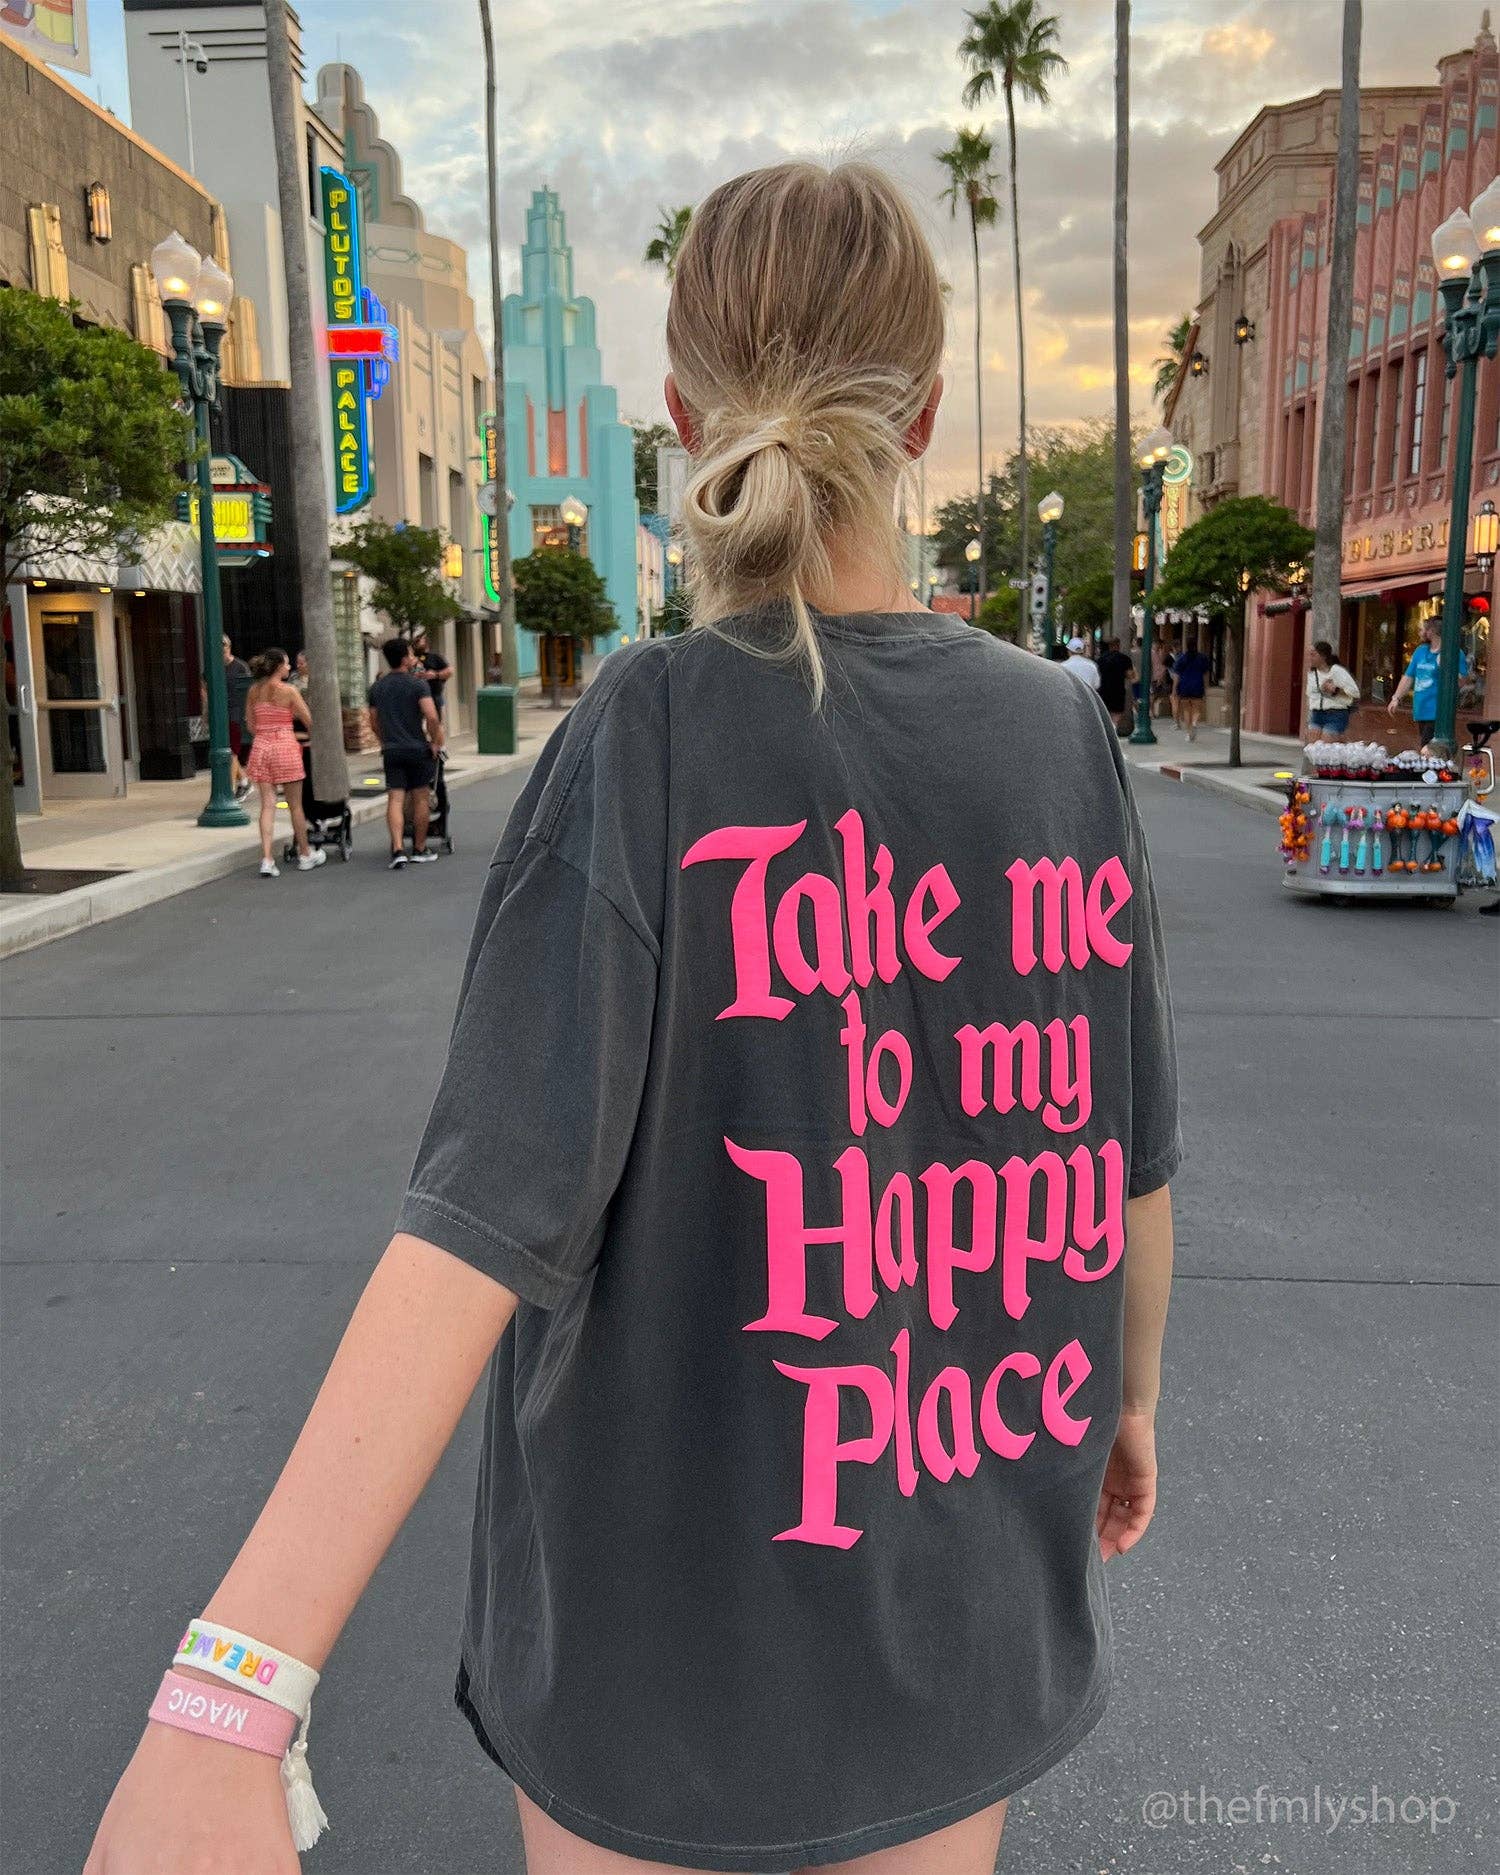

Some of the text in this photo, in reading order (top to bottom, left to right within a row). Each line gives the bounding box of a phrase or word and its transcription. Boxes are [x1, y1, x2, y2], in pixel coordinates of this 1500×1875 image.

[337, 369, 359, 492] PALACE
[682, 809, 1133, 1021] Take me
[840, 989, 1092, 1136] to my
[724, 1136, 1125, 1341] Happy
[772, 1328, 1092, 1549] Place
[168, 1688, 249, 1732] MAGIC
